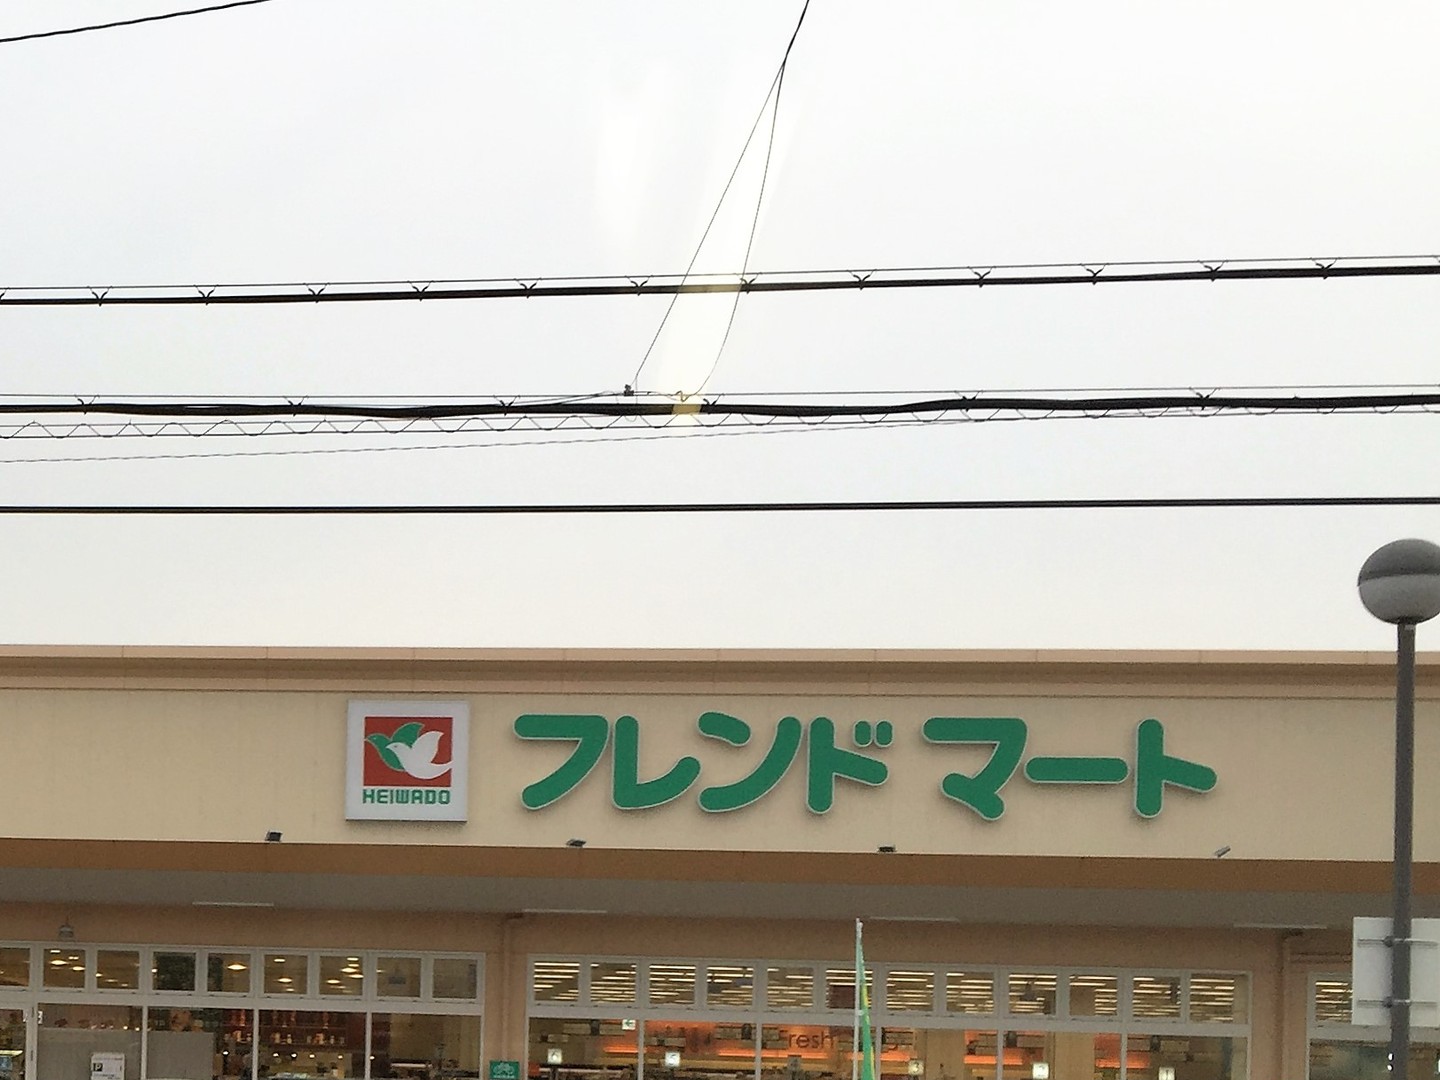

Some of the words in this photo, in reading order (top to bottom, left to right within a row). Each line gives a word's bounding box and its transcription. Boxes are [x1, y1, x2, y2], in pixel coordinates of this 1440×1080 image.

[514, 711, 890, 814] フレンド
[922, 717, 1218, 818] マート
[362, 788, 451, 805] HEIWADO
